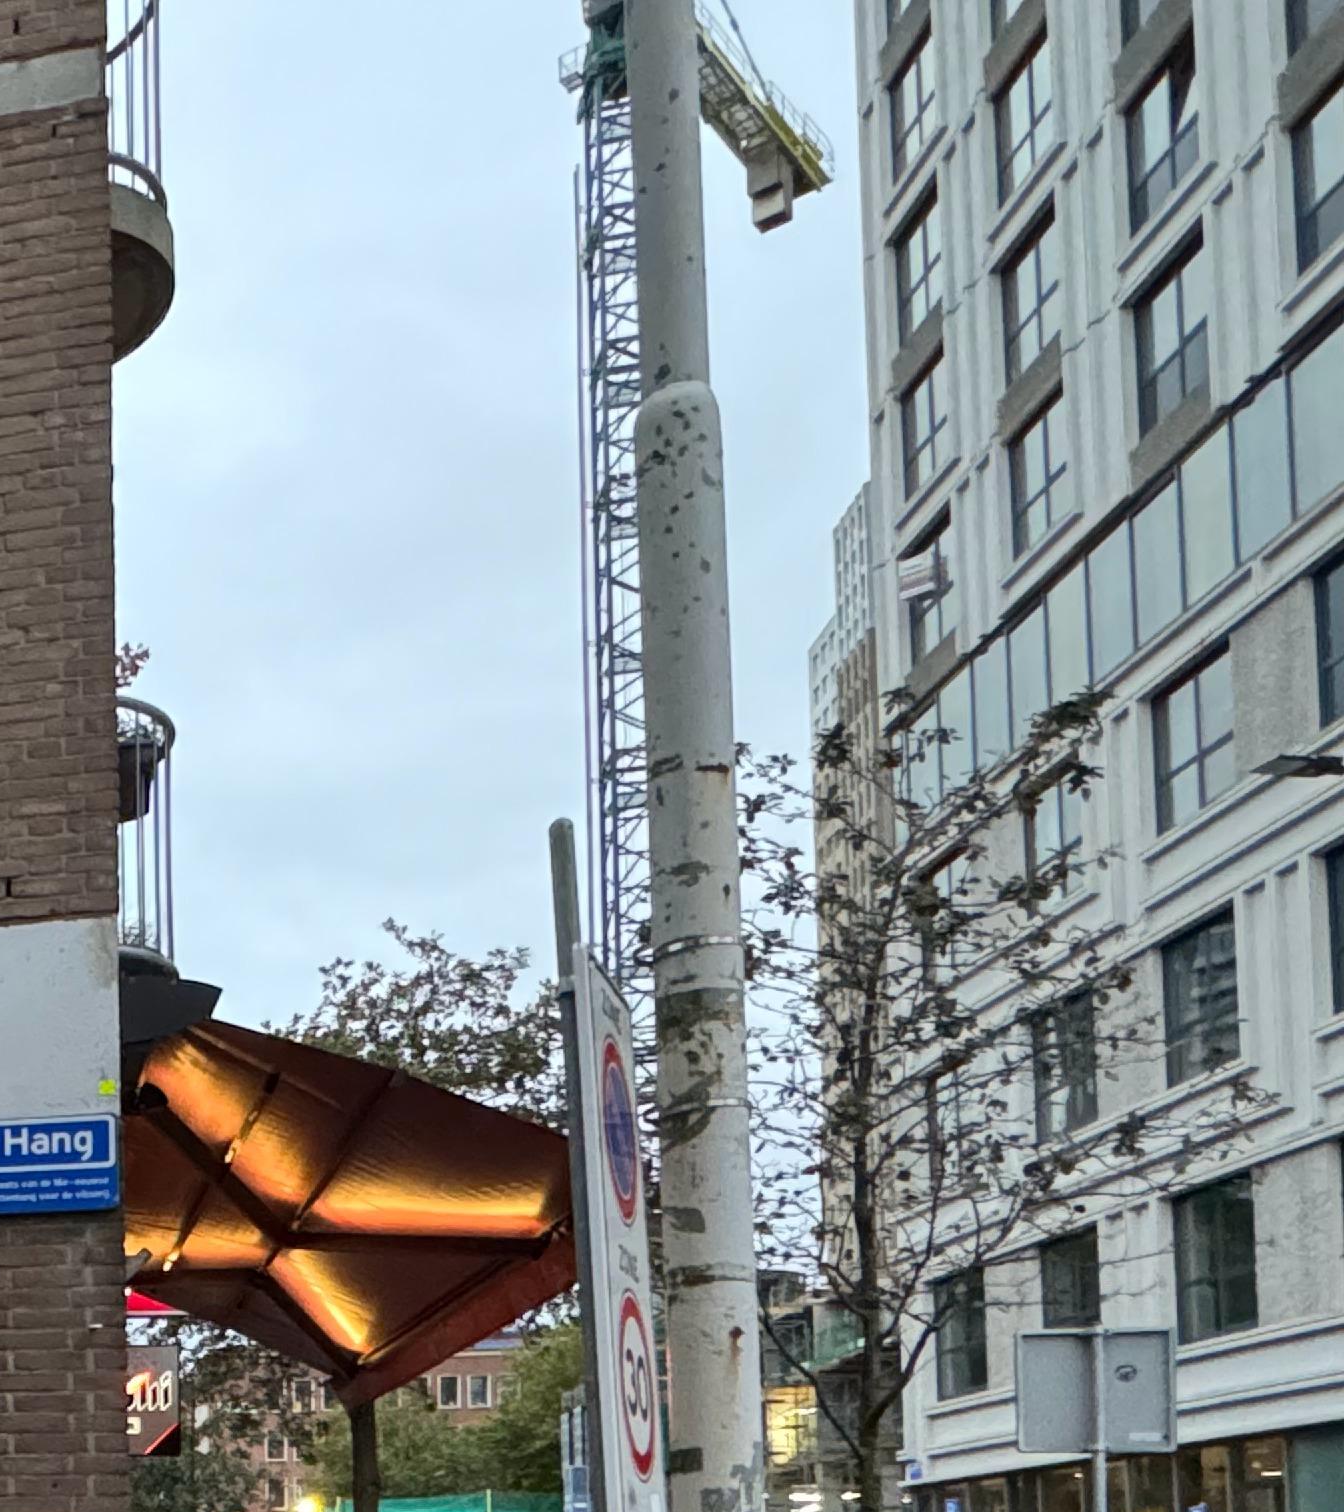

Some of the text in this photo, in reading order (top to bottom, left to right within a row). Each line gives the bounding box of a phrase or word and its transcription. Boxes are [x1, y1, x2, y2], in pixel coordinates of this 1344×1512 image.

[3, 1127, 93, 1161] Hang
[617, 1243, 640, 1284] ZONE
[626, 1345, 648, 1424] 30
